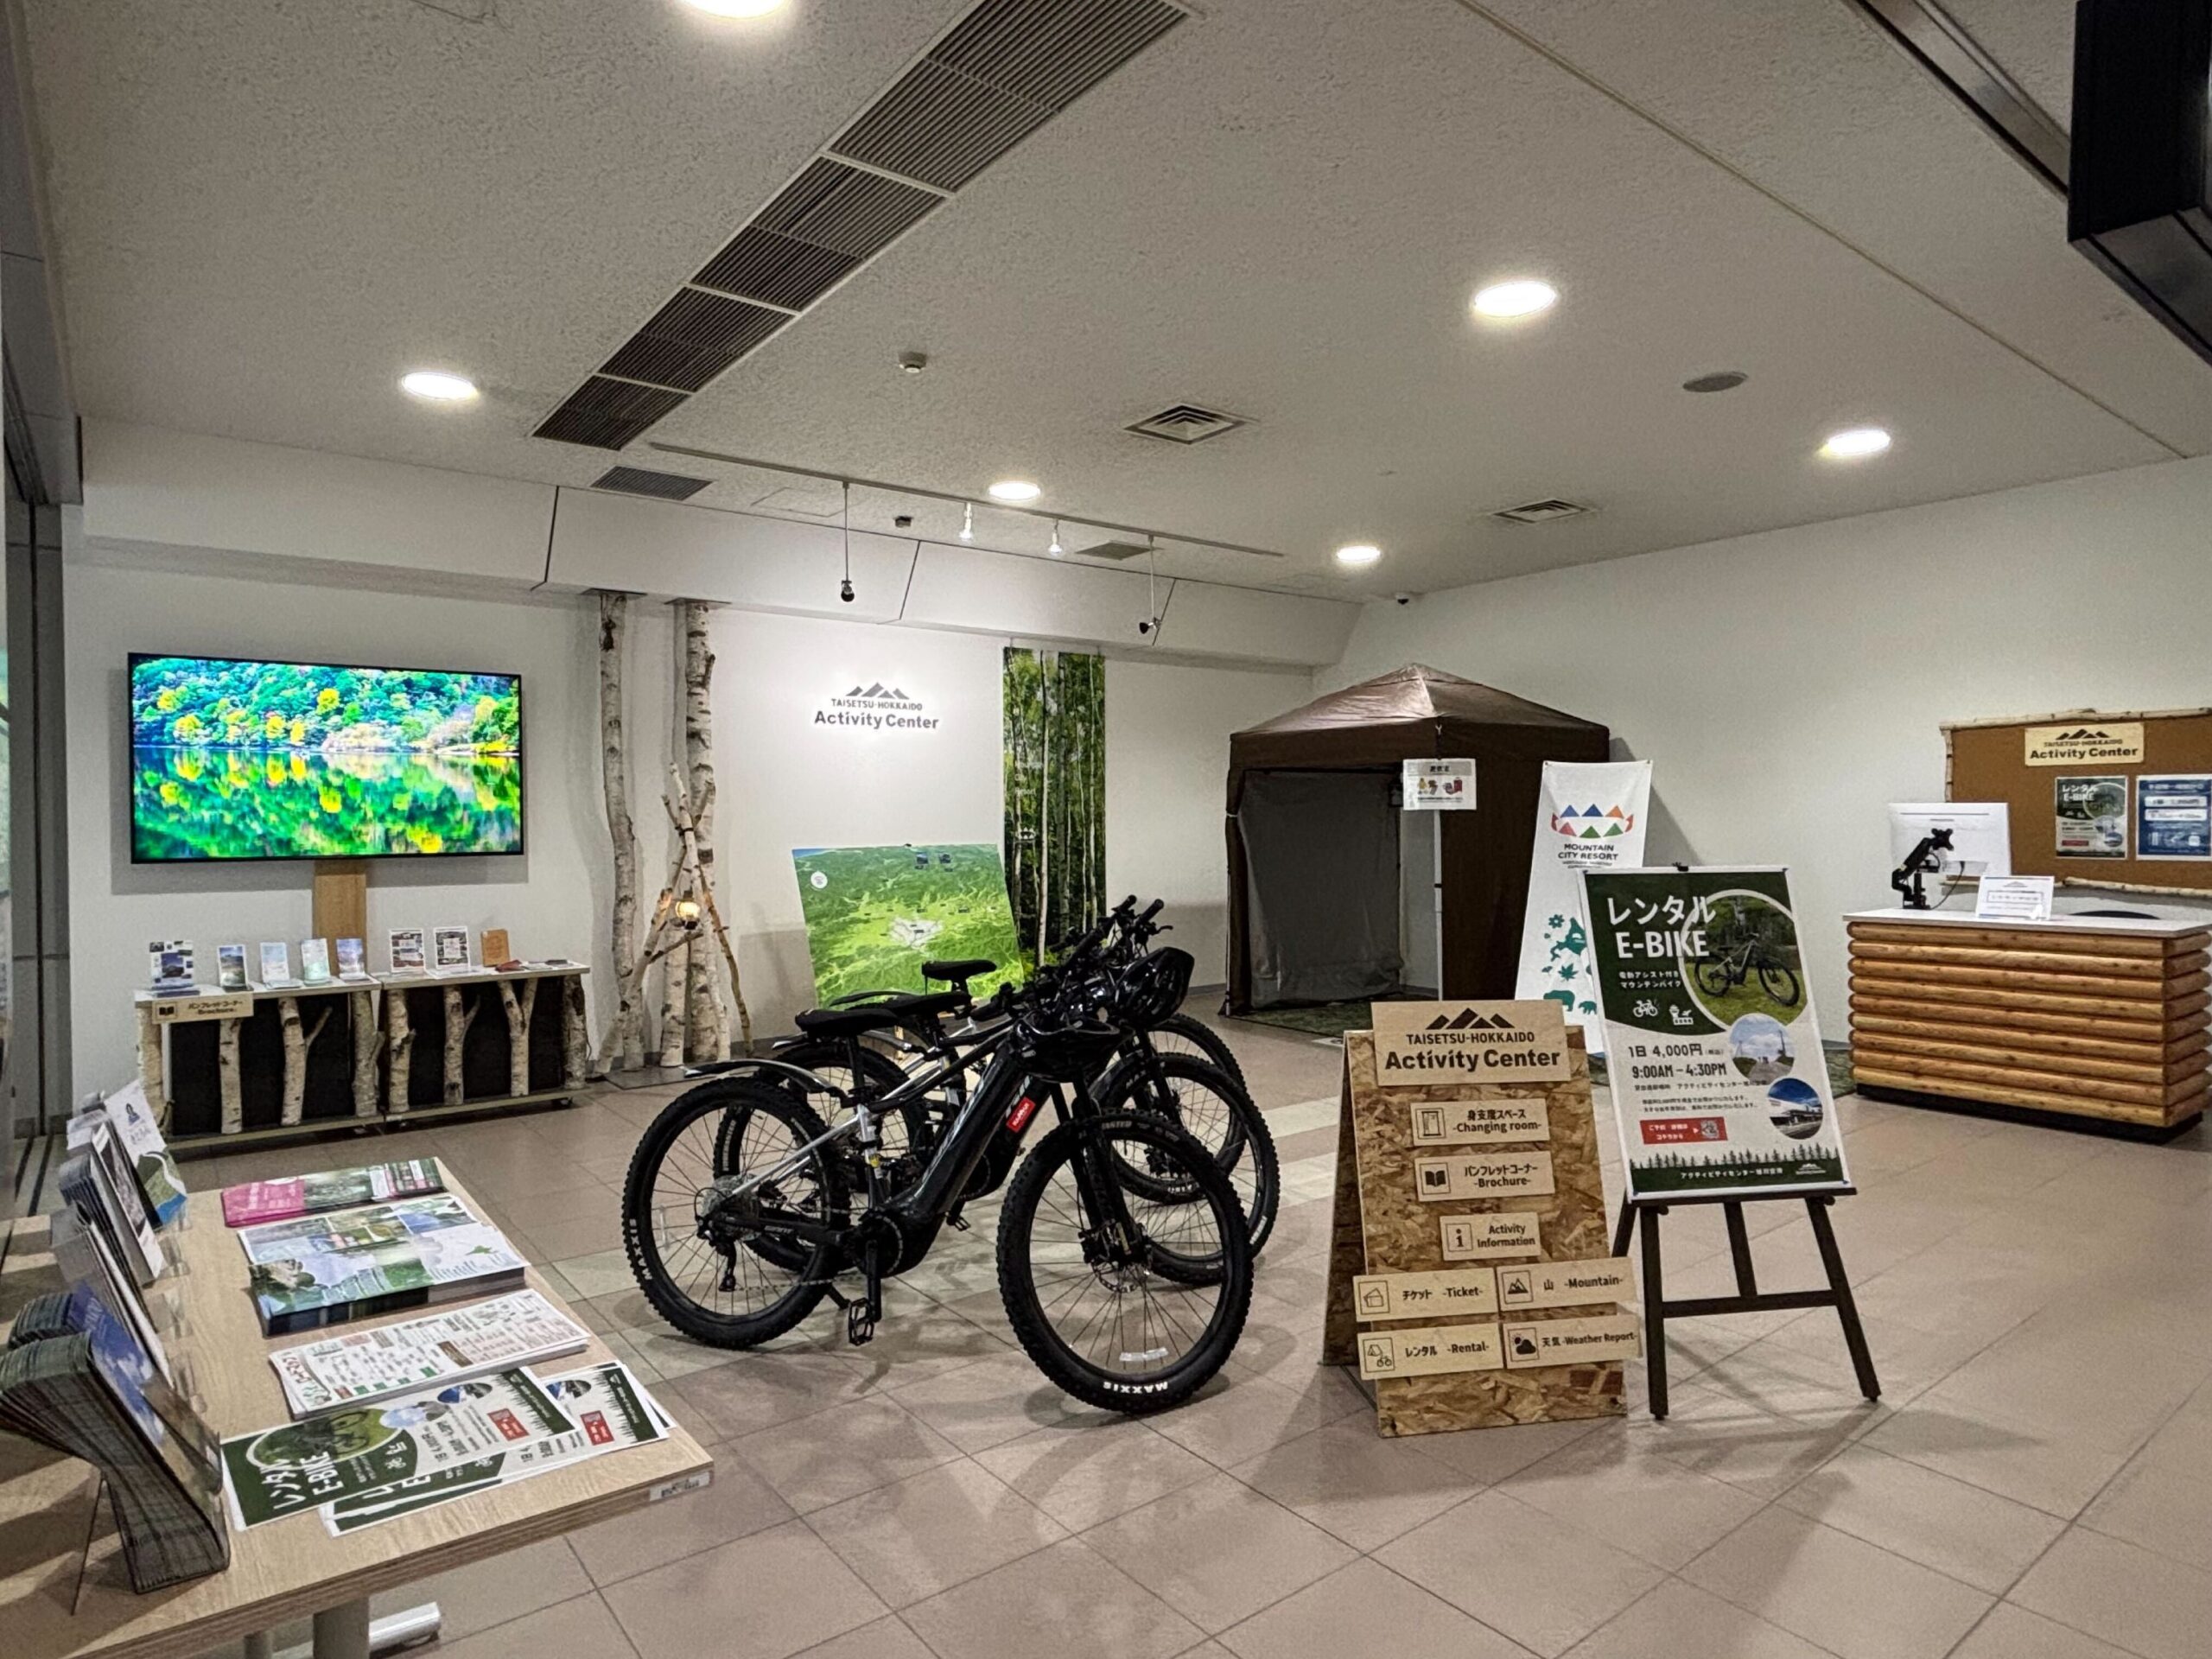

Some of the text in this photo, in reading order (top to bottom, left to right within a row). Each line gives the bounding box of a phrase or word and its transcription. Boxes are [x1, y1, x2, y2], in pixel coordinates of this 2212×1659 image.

[814, 710, 939, 729] Activity Center
[2031, 747, 2139, 760] Activity Center
[1580, 852, 1618, 861] RESORT
[1607, 895, 1716, 925] レンタル
[1615, 931, 1710, 959] E-BIKE
[1620, 980, 1681, 988] マウンテンバイク
[1628, 1046, 1647, 1058] 1日
[1652, 1043, 1703, 1058] 4,000円
[1385, 1049, 1560, 1072] Activity Center
[1631, 1064, 1675, 1079] 9:00AM
[1686, 1063, 1727, 1077] 4:30PM
[1467, 1109, 1527, 1122] 身支度スペース
[1465, 1165, 1538, 1177] パンフレットコーナー
[1488, 1224, 1527, 1236] Activity
[629, 1218, 652, 1280] MAXXIS
[1477, 1236, 1536, 1249] Information
[1544, 1280, 1554, 1291] 山
[1402, 1289, 1433, 1300] チケット
[1542, 1338, 1560, 1348] 天気
[1405, 1345, 1438, 1357] レンタル
[1103, 1382, 1168, 1394] MAXXIS
[300, 1451, 344, 1496] E-BIKE
[260, 1459, 306, 1510] レンタル
